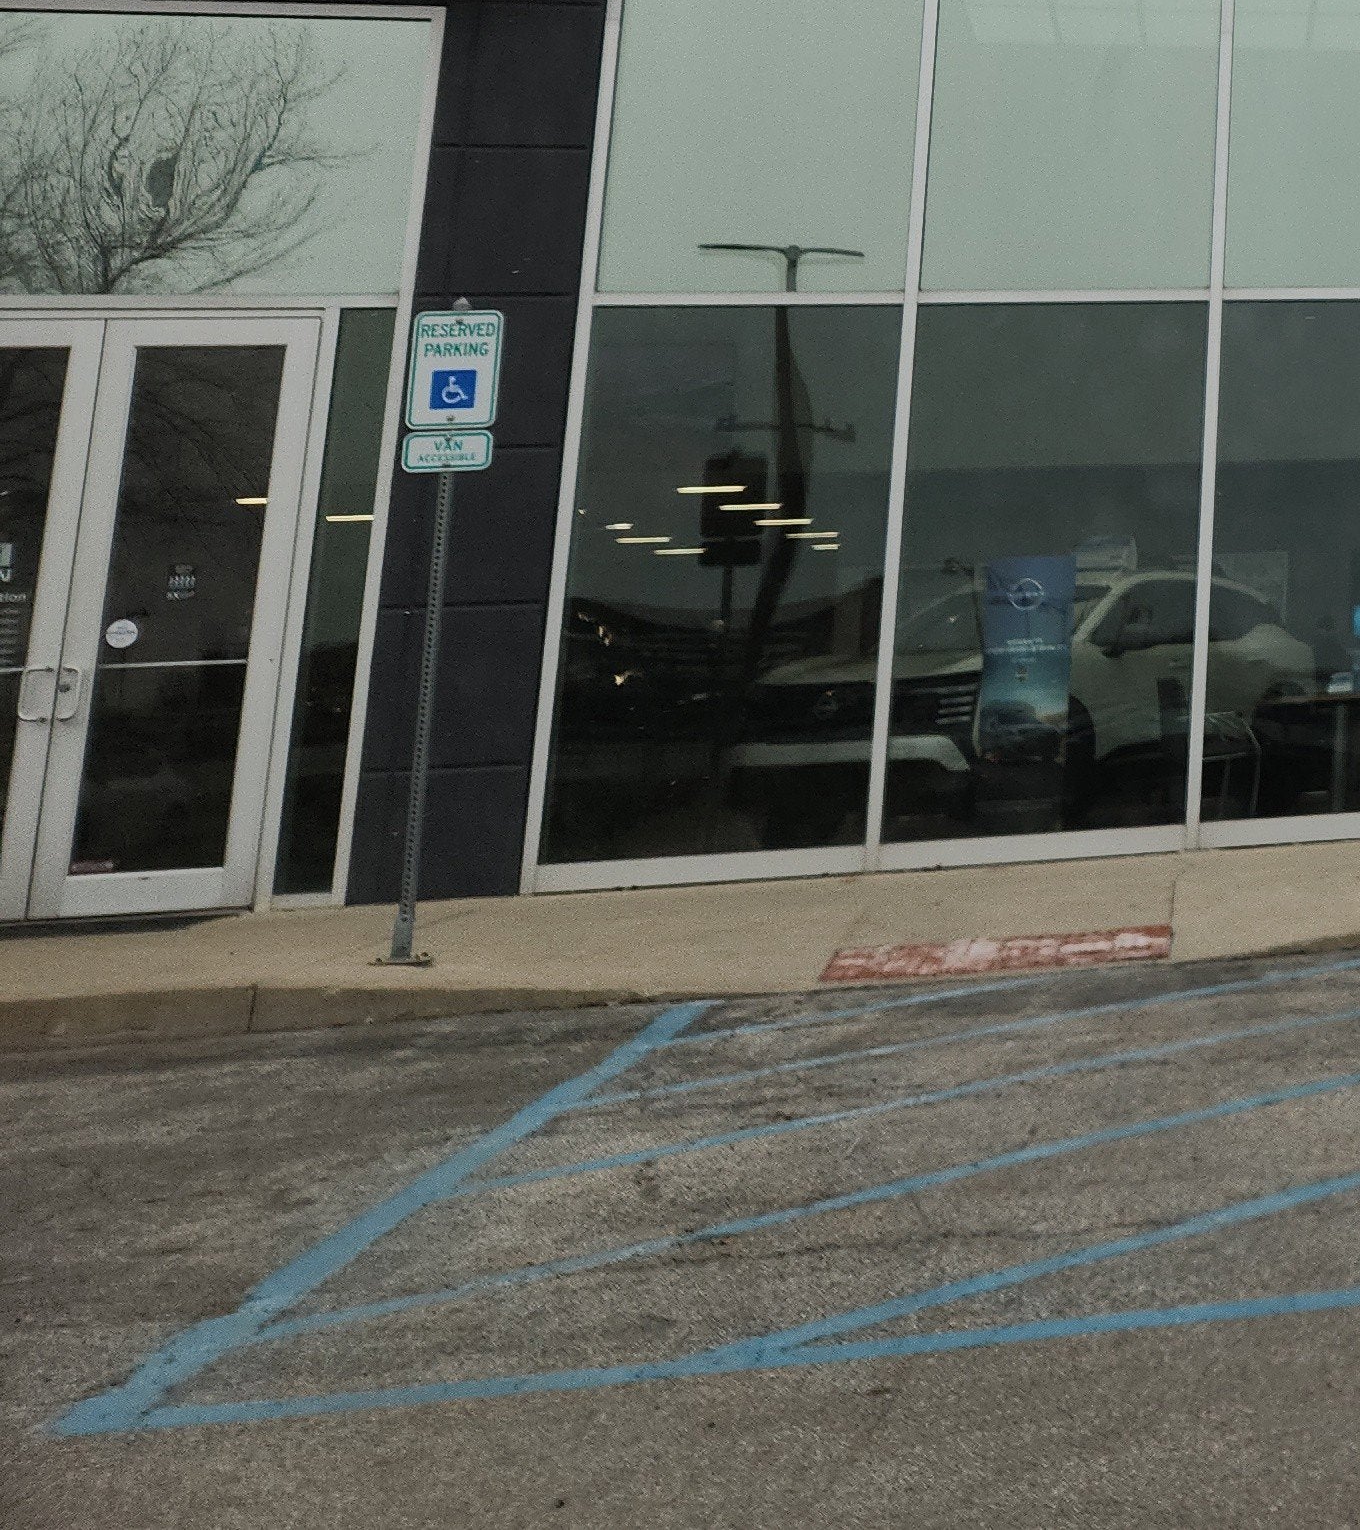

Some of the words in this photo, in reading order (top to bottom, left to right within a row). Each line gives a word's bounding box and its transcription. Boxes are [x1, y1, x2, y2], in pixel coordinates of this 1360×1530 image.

[421, 322, 496, 338] RESERVED
[424, 342, 489, 358] PARKING
[434, 439, 464, 451] VAN
